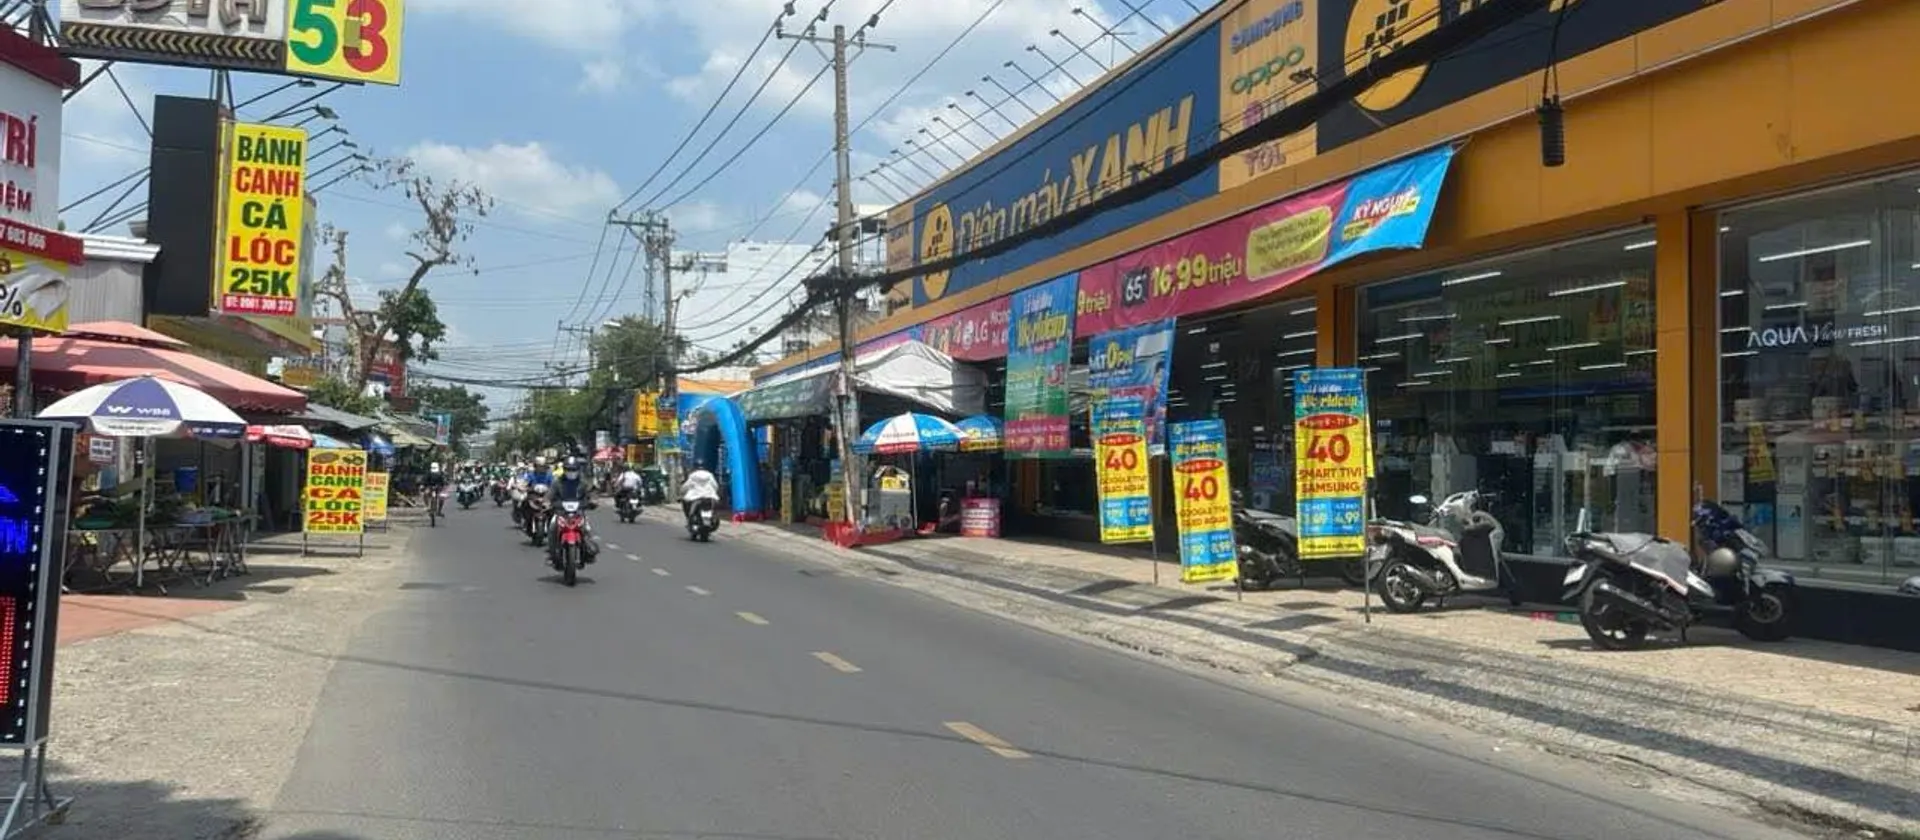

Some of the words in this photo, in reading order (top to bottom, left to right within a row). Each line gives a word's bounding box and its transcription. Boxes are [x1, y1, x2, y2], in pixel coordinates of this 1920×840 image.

[290, 0, 388, 72] 53
[237, 132, 302, 166] BÁNH
[1067, 94, 1195, 210] XANH
[235, 166, 300, 197] CANH
[241, 198, 288, 230] CÁ
[230, 232, 296, 266] LÓC
[229, 267, 292, 297] 25K
[1151, 253, 1207, 297] 16,99
[1207, 256, 1243, 285] triệu
[1747, 326, 1808, 348] AQUA
[1847, 324, 1888, 339] FRESH
[1104, 448, 1138, 471] 40
[1305, 433, 1351, 463] 40
[1182, 475, 1219, 501] 40
[1299, 468, 1336, 481] SMART
[1338, 466, 1362, 479] TIVI
[1301, 480, 1361, 494] SAMSUNG
[308, 511, 359, 525] 25K
